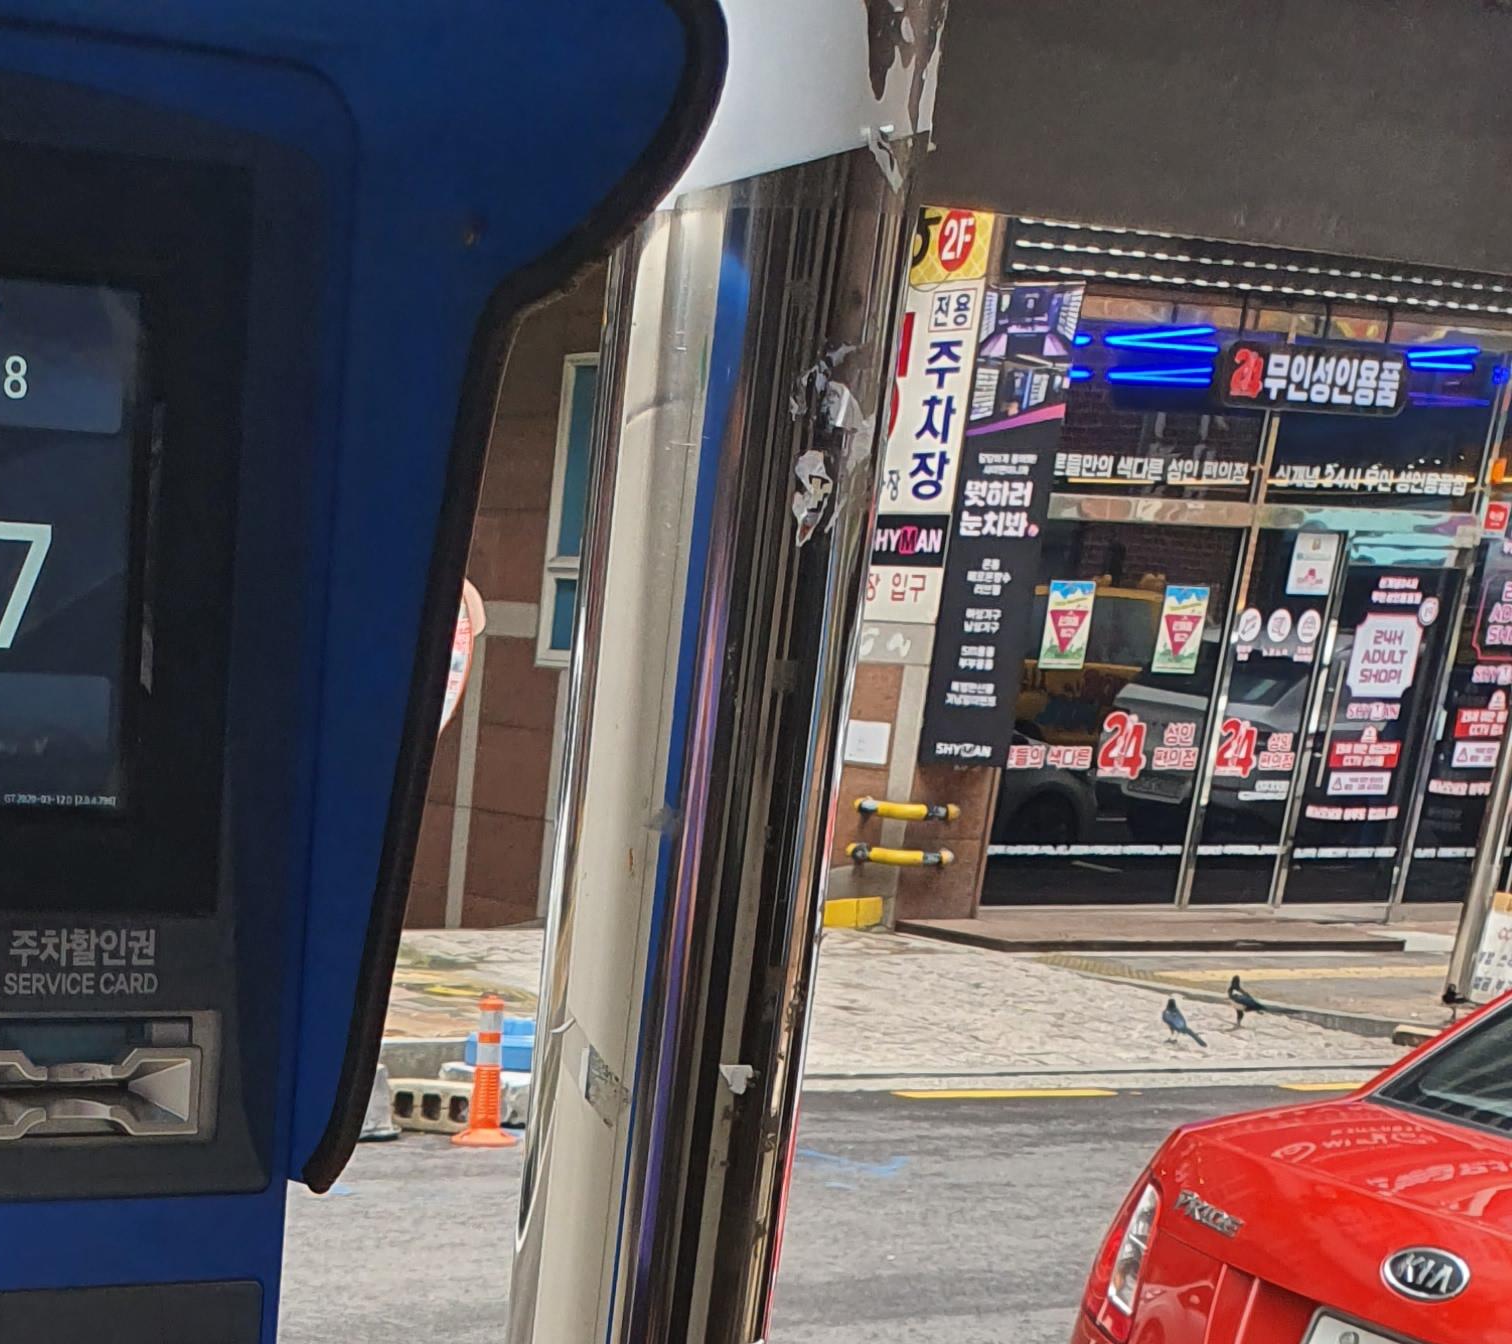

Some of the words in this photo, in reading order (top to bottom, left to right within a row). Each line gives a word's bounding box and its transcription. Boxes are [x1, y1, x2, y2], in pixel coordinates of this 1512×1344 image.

[941, 217, 975, 261] 2F
[934, 294, 971, 328] 전용
[3, 356, 28, 400] 8
[1264, 353, 1402, 408] 무인성인용품
[909, 340, 963, 501] 주차장
[1116, 456, 1164, 481] 색다른
[1167, 458, 1199, 481] 성인
[891, 573, 927, 603] 입구
[1373, 630, 1405, 645] 24H
[1361, 650, 1408, 664] ADULT
[1164, 723, 1196, 746] 성인
[1267, 733, 1293, 751] 성인
[1047, 746, 1093, 769] 색다른
[1152, 747, 1198, 770] 편의점
[1258, 752, 1295, 771] 편의점
[9, 929, 155, 968] 주차할인권
[3, 972, 94, 997] SERVICE
[99, 971, 159, 995] CARD
[1400, 1253, 1455, 1294] KIA
